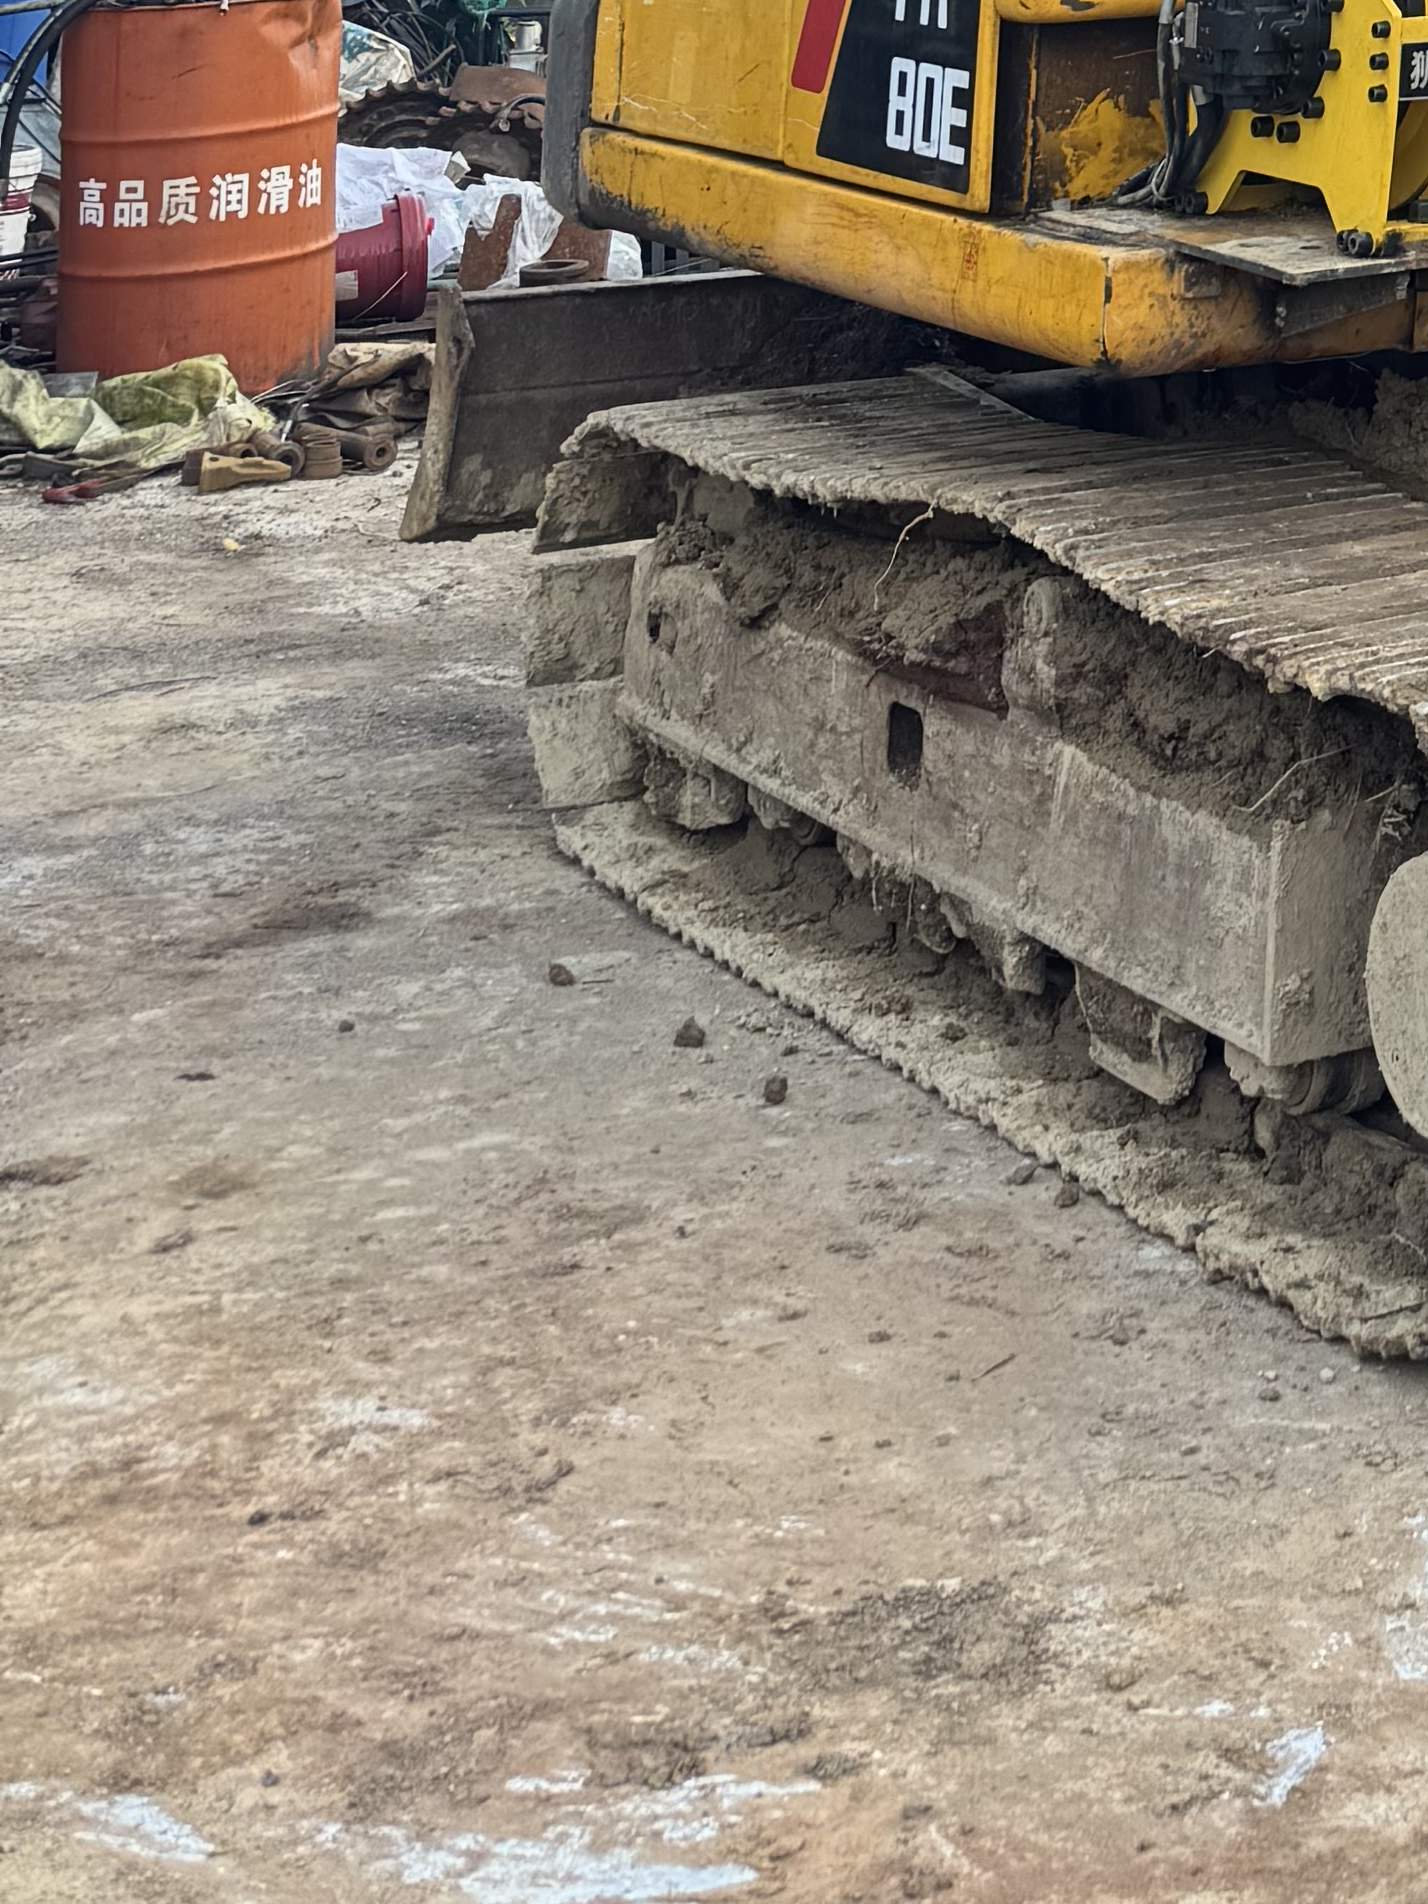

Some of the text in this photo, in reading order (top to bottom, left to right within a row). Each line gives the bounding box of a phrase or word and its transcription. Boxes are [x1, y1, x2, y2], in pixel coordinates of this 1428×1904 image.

[886, 56, 970, 166] 80E
[79, 158, 322, 228] 高品质润滑油
